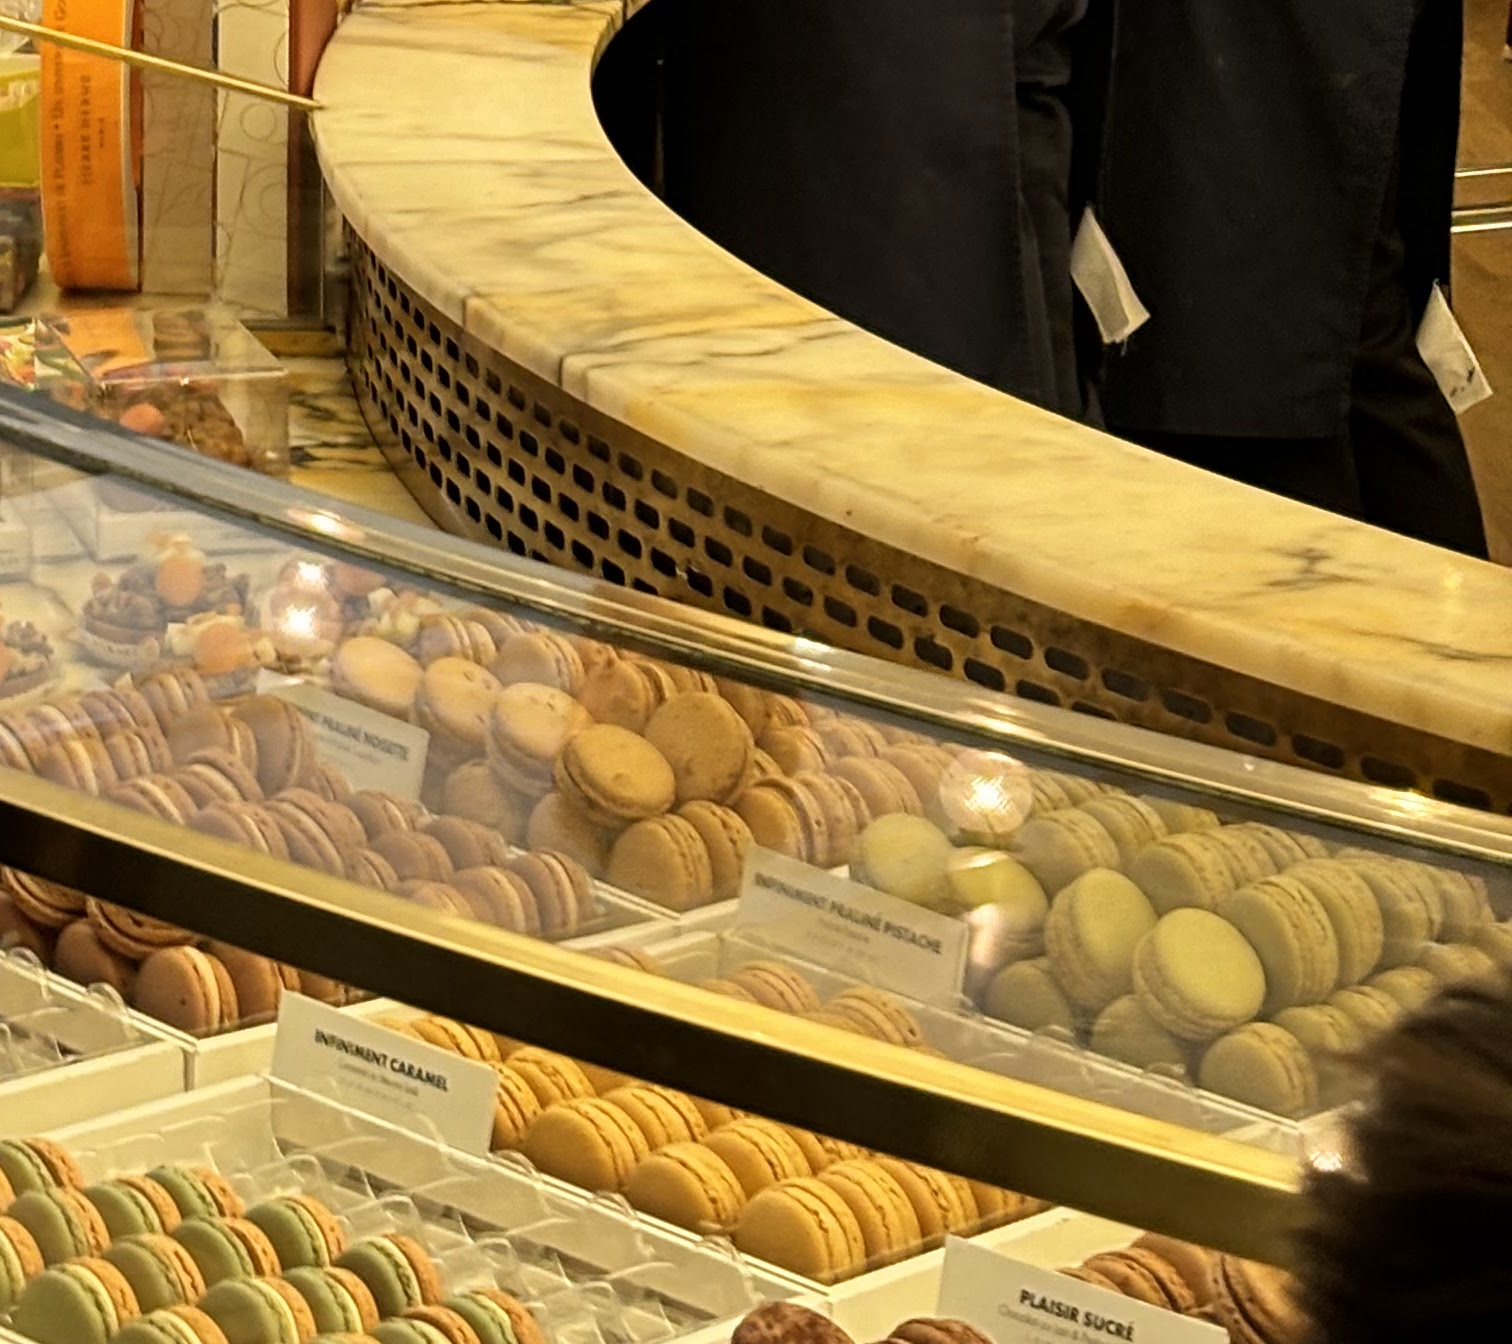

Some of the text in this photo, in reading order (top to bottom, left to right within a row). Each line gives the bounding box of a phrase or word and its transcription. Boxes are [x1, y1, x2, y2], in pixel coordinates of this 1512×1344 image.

[315, 1028, 388, 1067] INFINIMENT
[390, 1057, 448, 1093] CARAMEL
[1019, 1288, 1079, 1323] PLAISIR
[1082, 1311, 1135, 1342] SUCRÉ
